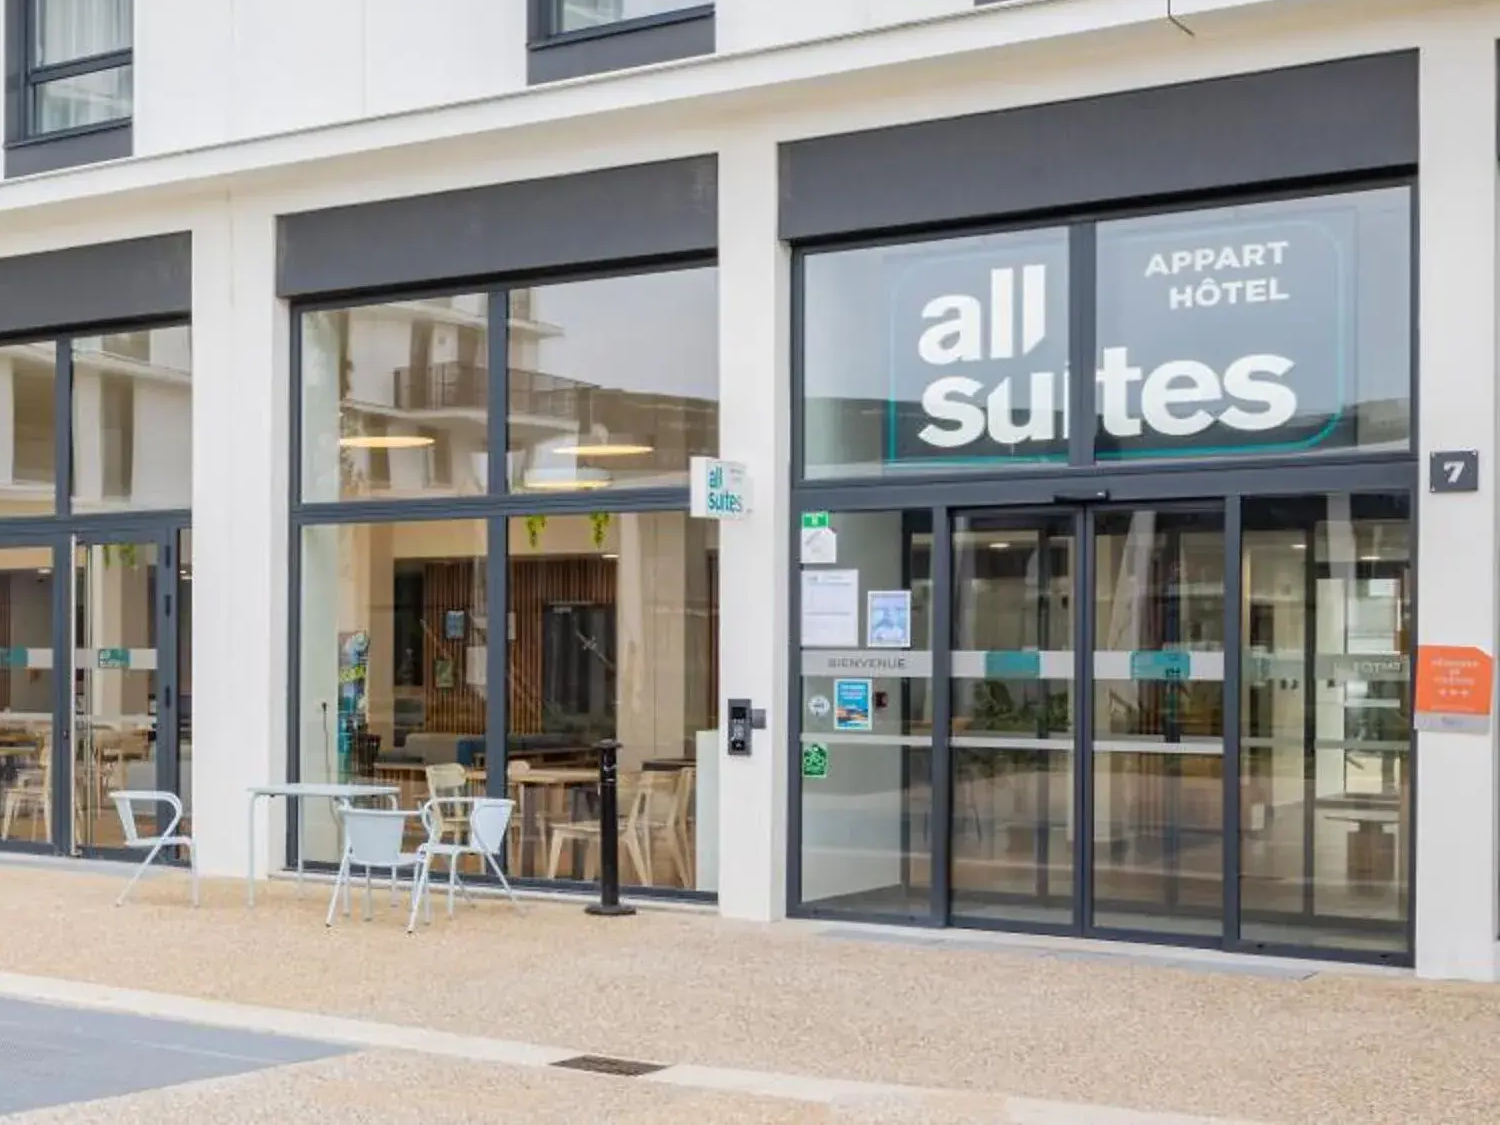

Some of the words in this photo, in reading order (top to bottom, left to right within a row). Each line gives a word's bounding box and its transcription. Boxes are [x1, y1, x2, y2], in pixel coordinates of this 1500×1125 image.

[1144, 240, 1290, 277] APPART
[1169, 277, 1290, 310] HÔTEL
[918, 263, 1046, 366] all
[917, 346, 1298, 448] sutes
[1443, 460, 1465, 484] 7
[827, 657, 907, 669] BIENVENUE
